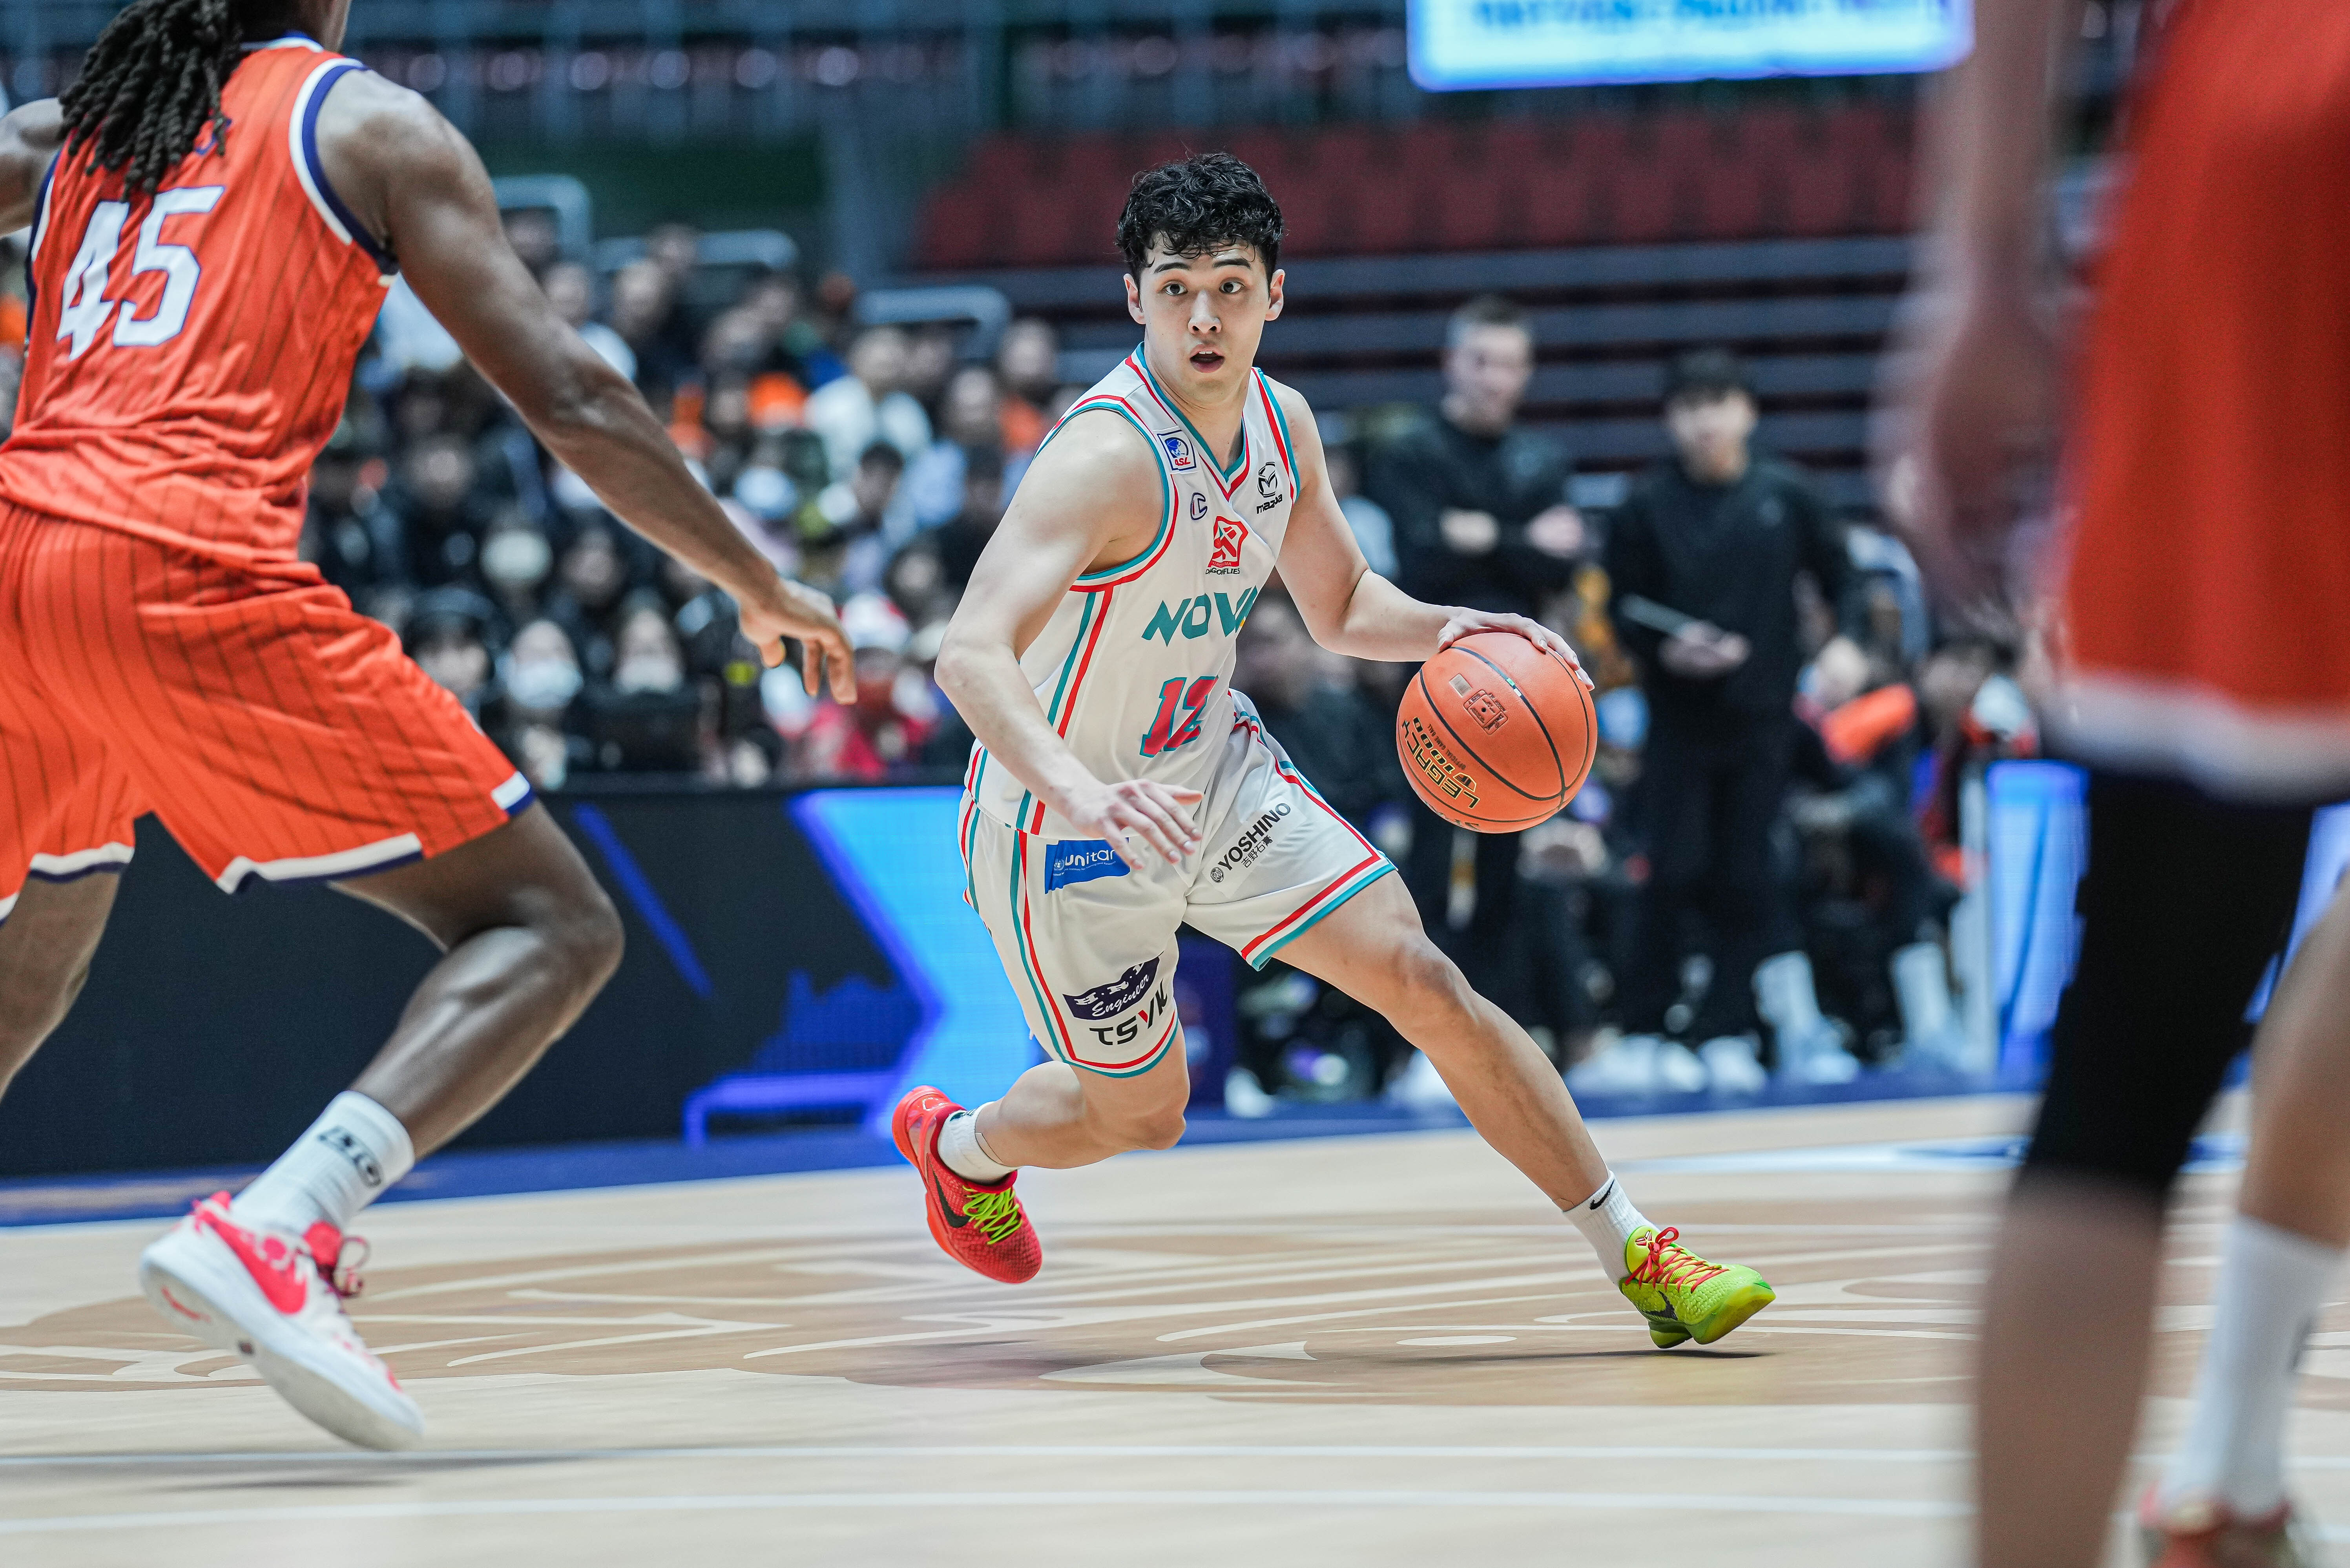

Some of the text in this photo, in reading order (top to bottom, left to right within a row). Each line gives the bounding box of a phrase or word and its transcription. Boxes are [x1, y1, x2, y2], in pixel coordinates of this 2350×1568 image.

[57, 185, 225, 361] 45
[1256, 494, 1283, 514] mazda
[1139, 675, 1219, 758] 12
[1401, 719, 1480, 809] LEGACY
[1413, 717, 1456, 774] 1000
[1427, 723, 1467, 770] OFFICIAL GAME BALL
[1065, 849, 1116, 867] unitar
[1217, 803, 1291, 871] YOSHINO
[1092, 974, 1149, 1017] Engineer
